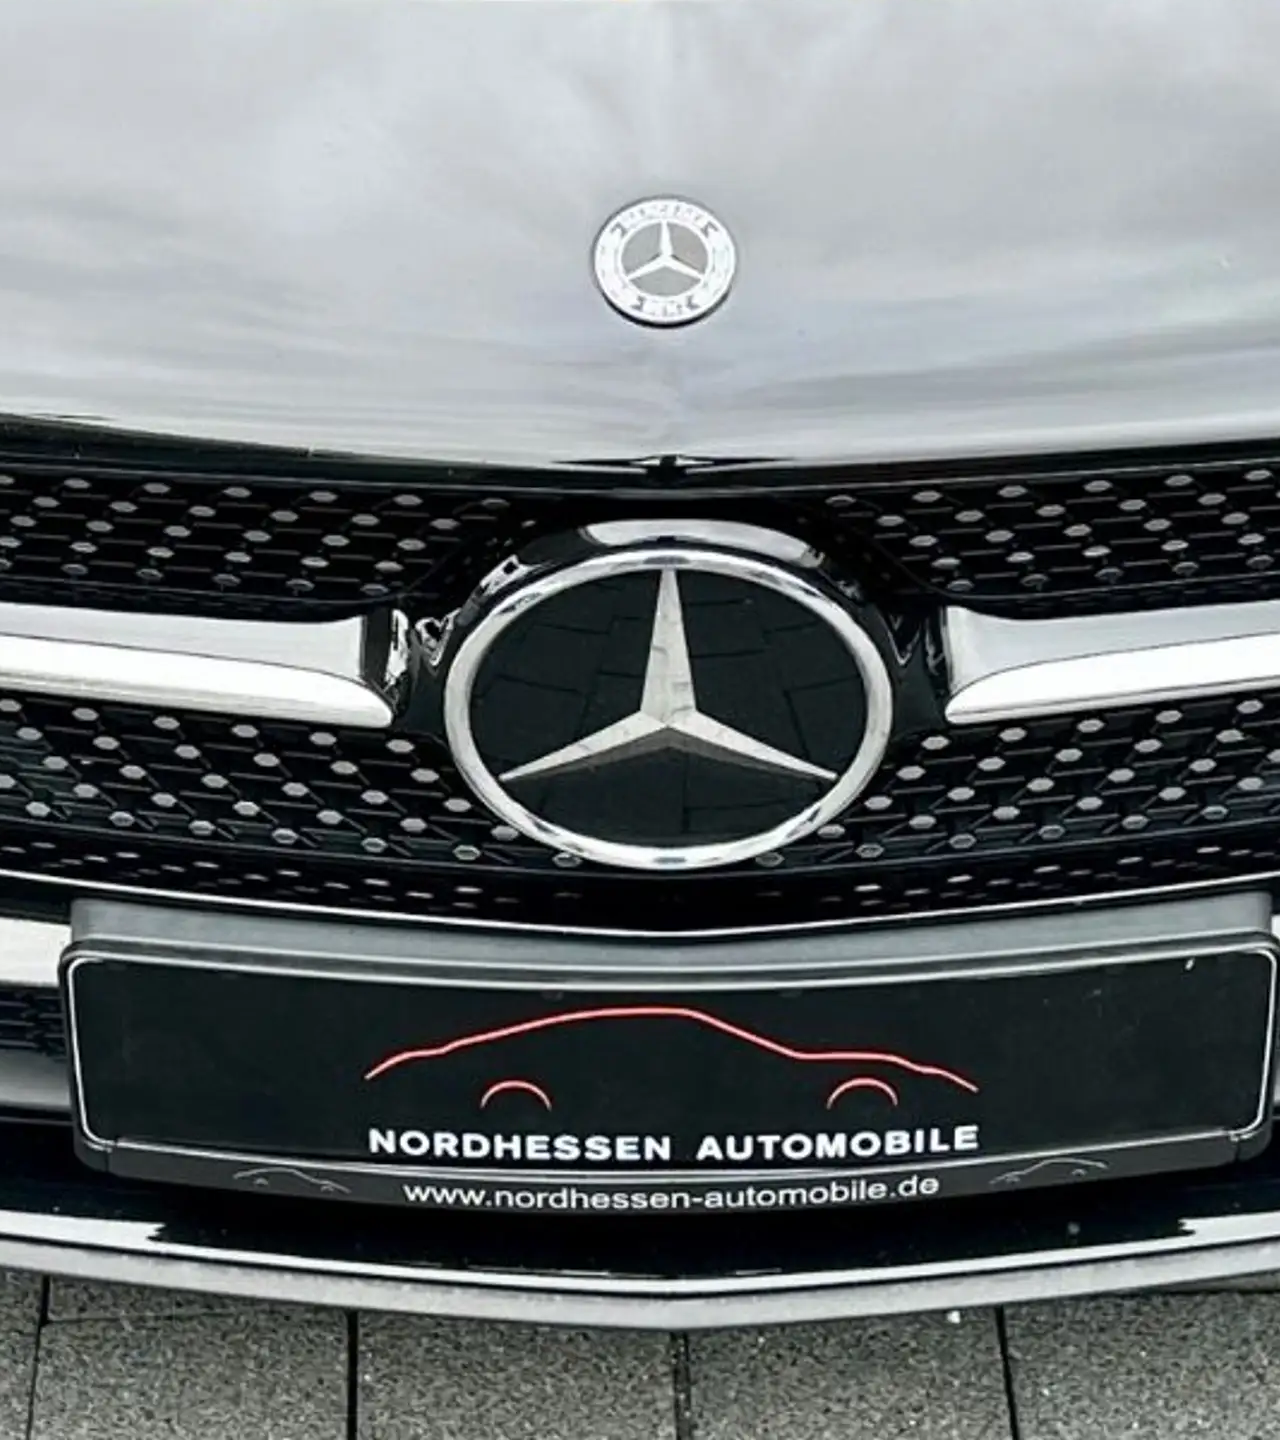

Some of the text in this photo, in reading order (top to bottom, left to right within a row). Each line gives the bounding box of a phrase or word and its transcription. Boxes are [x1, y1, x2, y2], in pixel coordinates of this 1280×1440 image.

[369, 1125, 980, 1161] NORDHESSEN AUTOMOBILE
[403, 1174, 940, 1211] www.nordhessen-automobile.de
